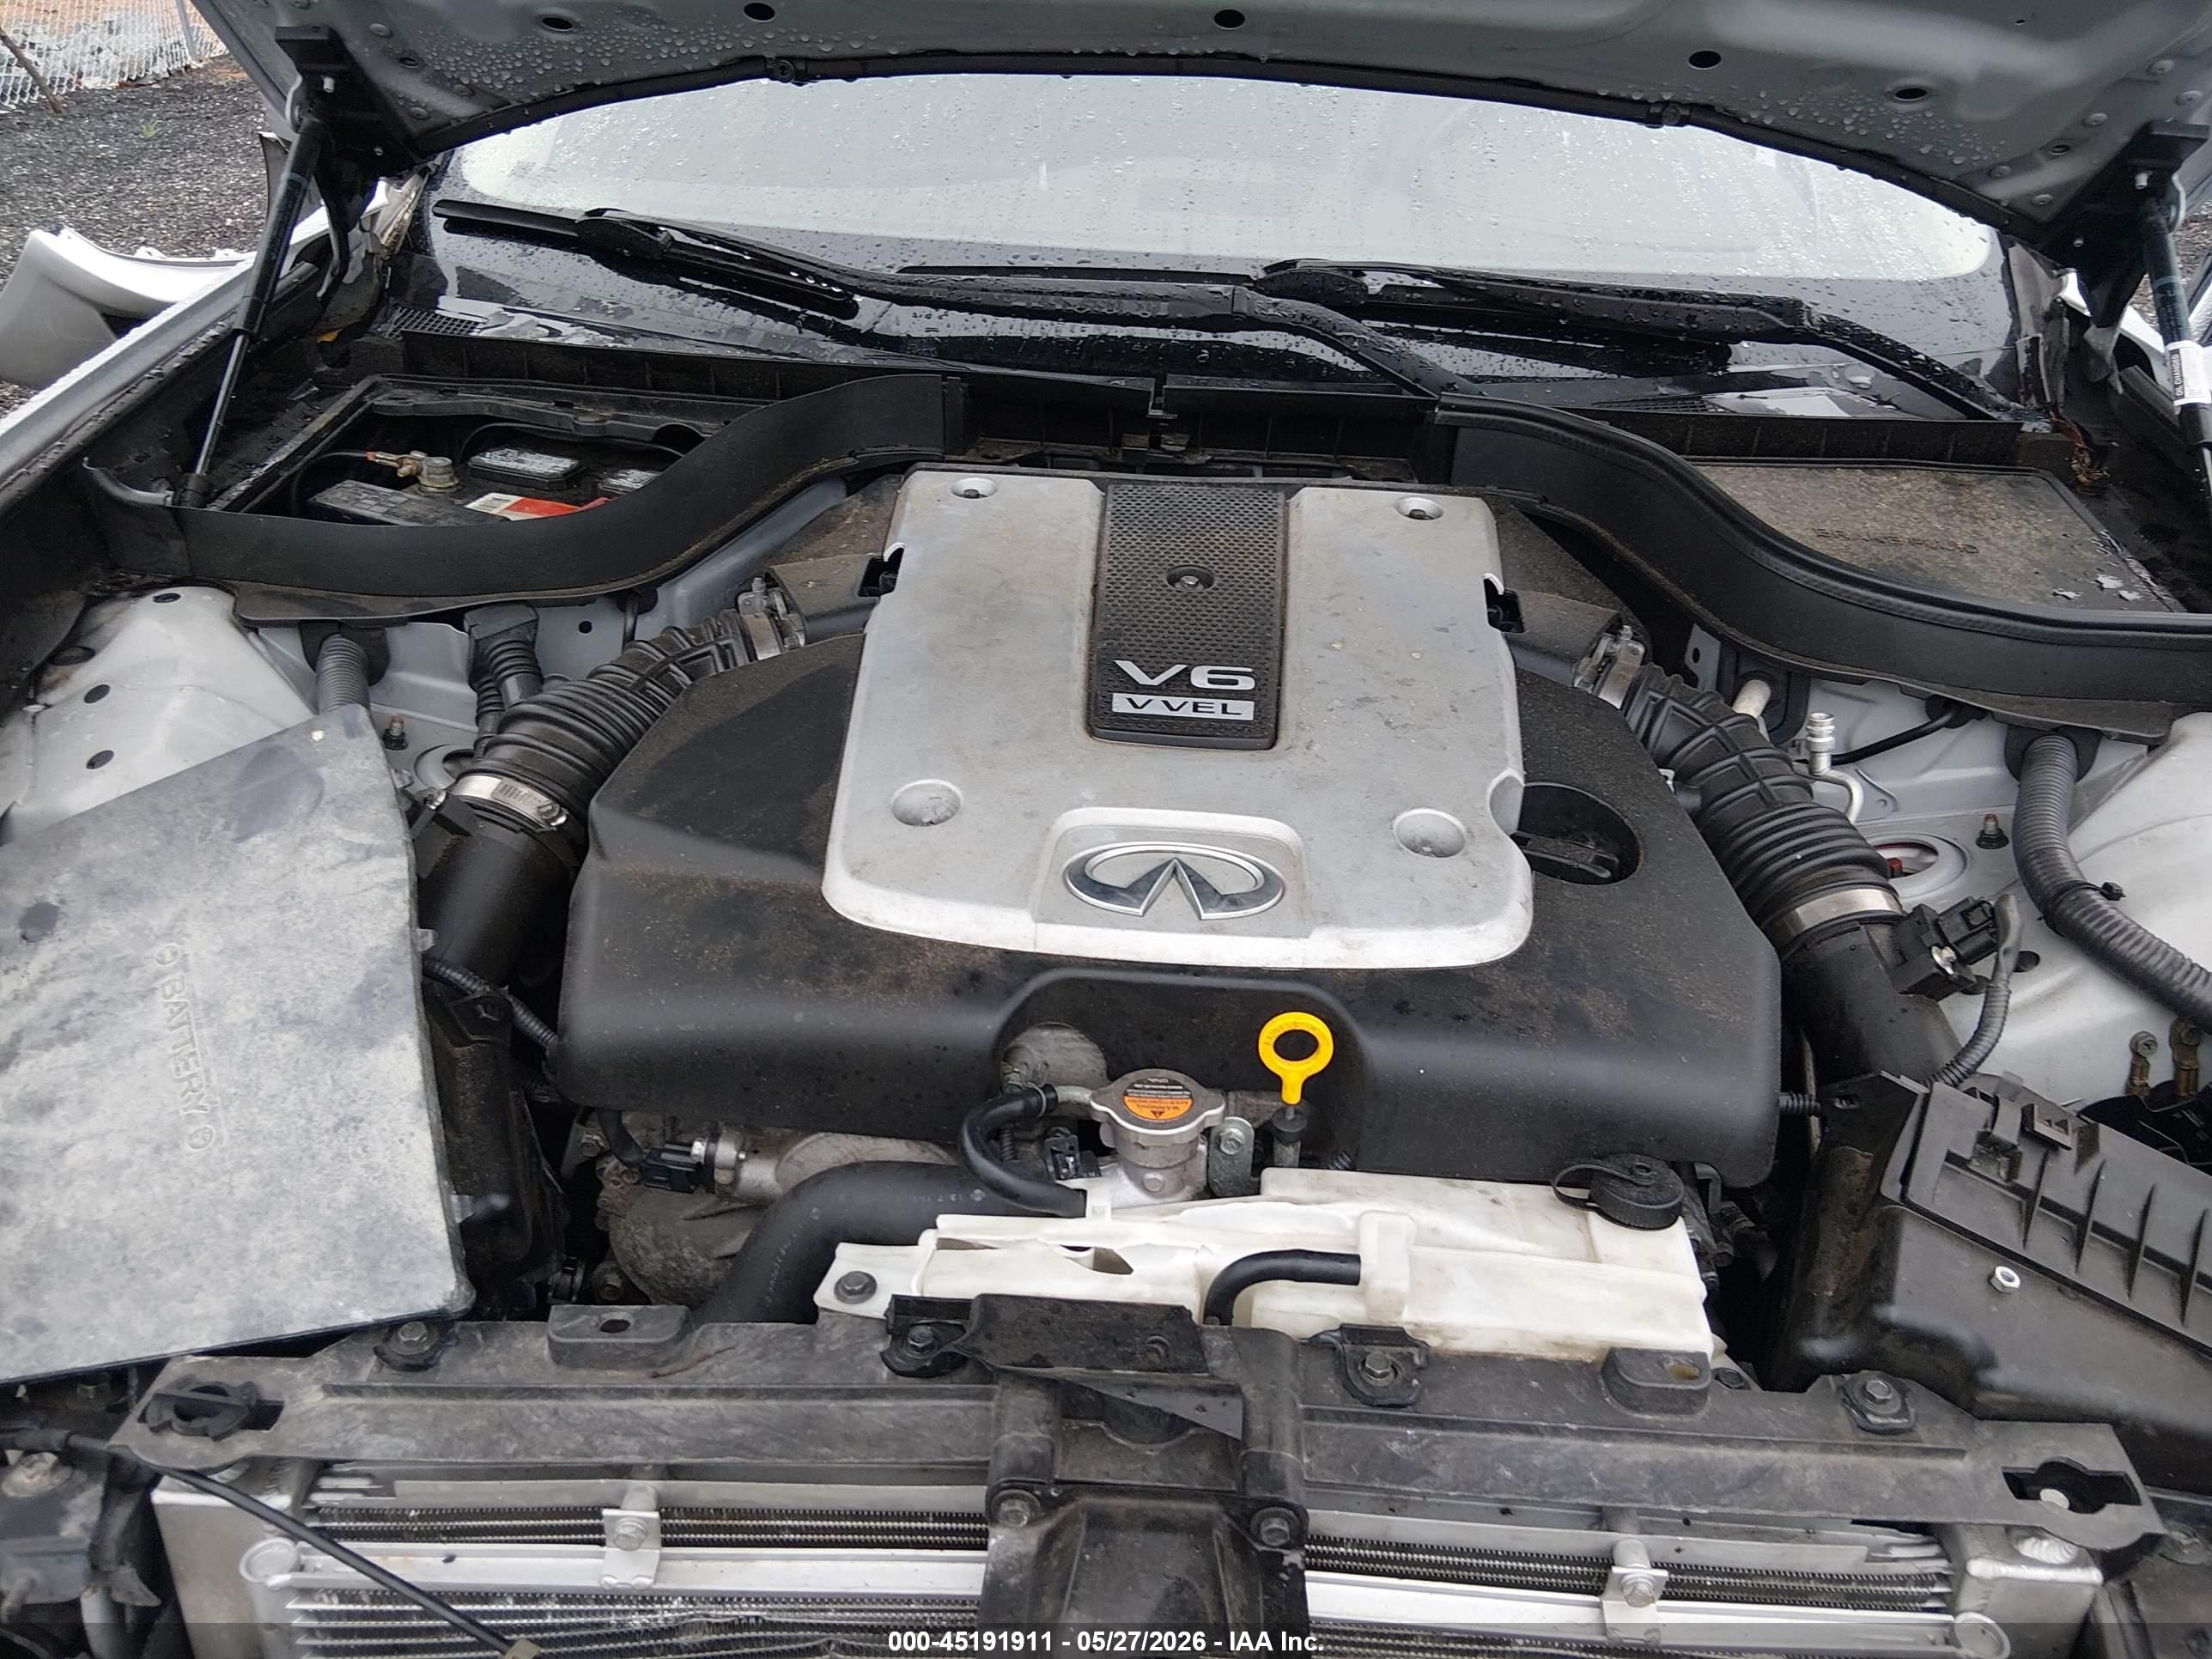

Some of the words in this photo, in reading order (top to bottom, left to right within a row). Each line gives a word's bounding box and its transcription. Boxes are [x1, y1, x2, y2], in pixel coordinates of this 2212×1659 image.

[1113, 659, 1256, 690] V6
[1126, 697, 1243, 715] VVEL
[160, 975, 210, 1115] BATTERY
